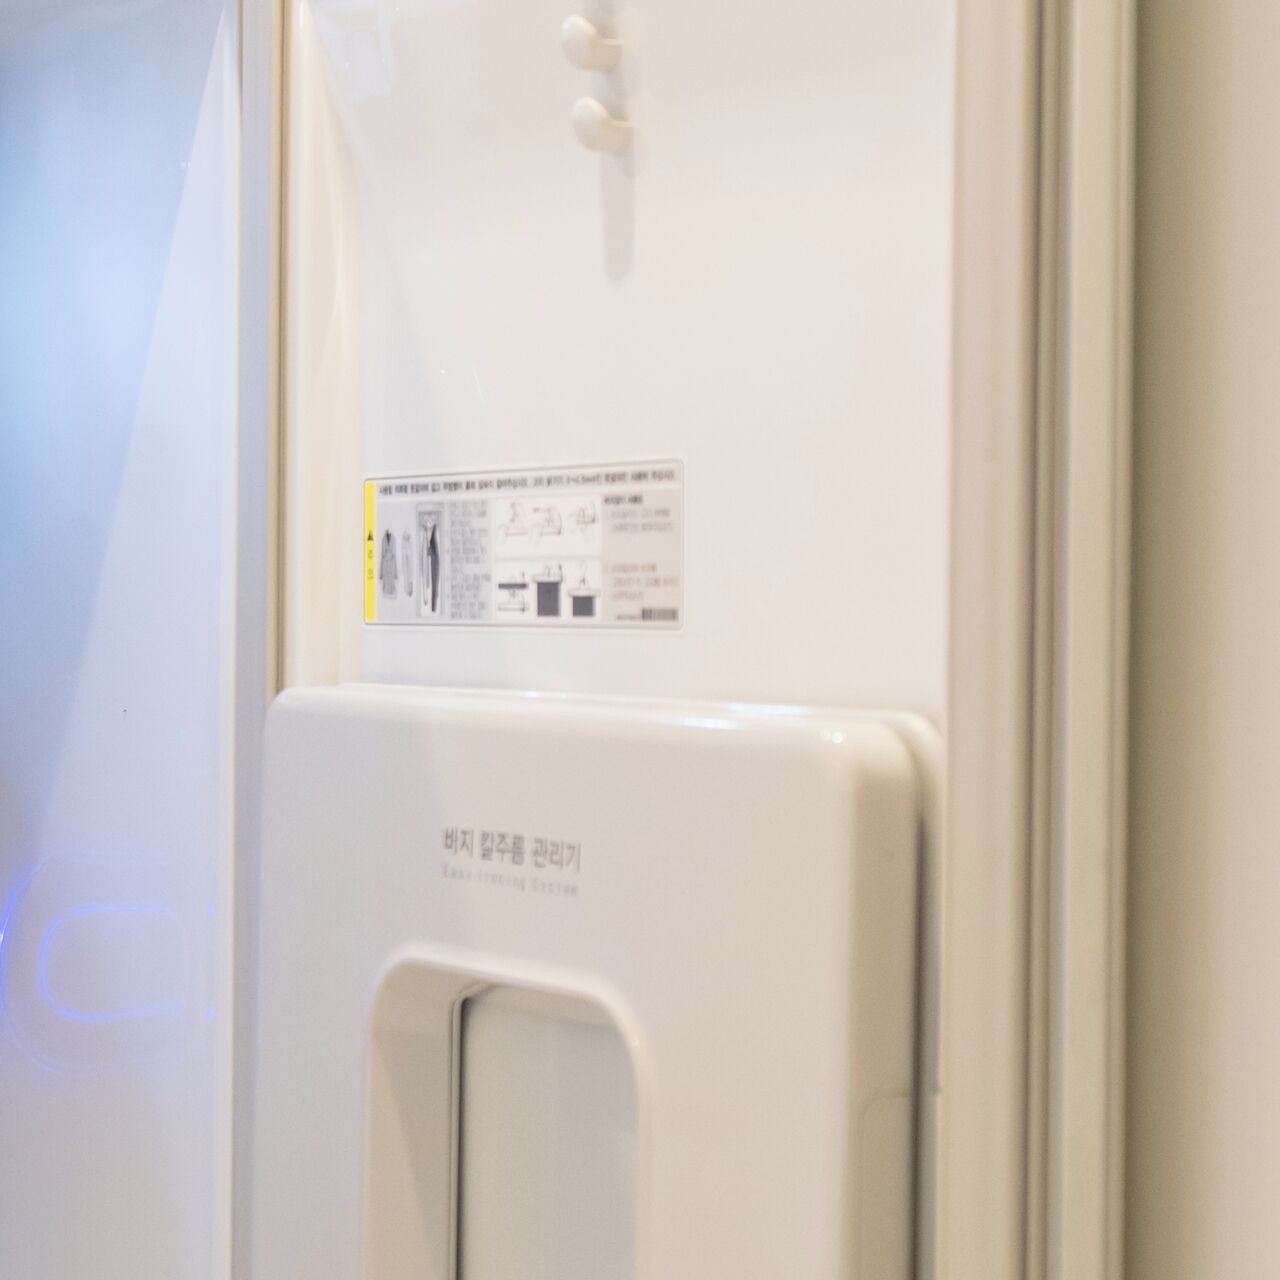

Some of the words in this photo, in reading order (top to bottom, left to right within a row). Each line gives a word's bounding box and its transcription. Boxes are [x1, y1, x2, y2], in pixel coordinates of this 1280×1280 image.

[443, 826, 474, 859] 바지
[480, 830, 525, 866] 칼주름
[532, 836, 581, 873] 관리기
